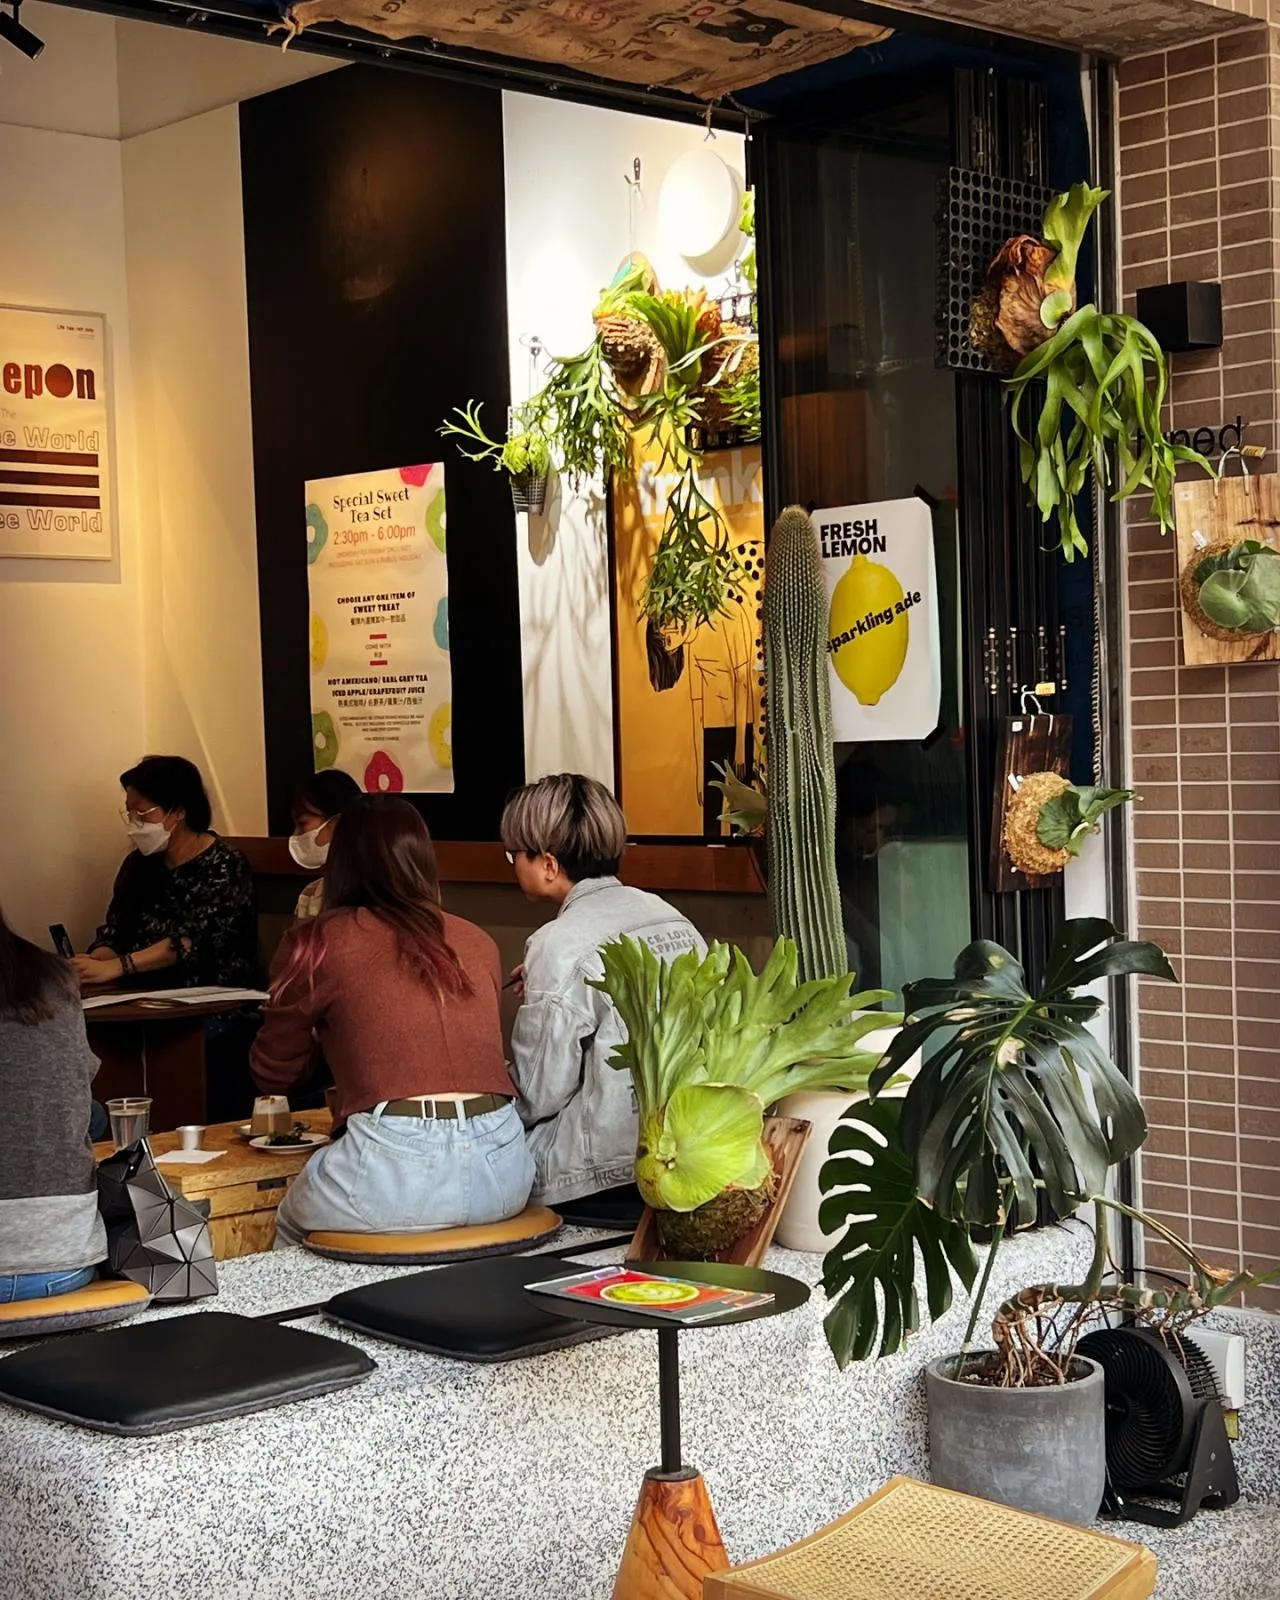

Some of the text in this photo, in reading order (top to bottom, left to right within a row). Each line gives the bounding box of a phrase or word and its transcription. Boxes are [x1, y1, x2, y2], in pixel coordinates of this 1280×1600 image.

[23, 426, 99, 451] World
[333, 487, 409, 512] Special Sweet
[26, 508, 102, 533] World
[350, 506, 392, 524] Tea Set
[333, 530, 368, 546] 2:30pm
[820, 519, 877, 541] FRESH
[822, 536, 886, 558] LEMON
[337, 596, 361, 605] CHOOSE
[362, 594, 375, 603] ANY
[376, 593, 390, 602] ONE
[353, 603, 400, 614] SWEET TREAT
[825, 591, 921, 653] sparkling ade
[327, 678, 341, 686] HOT
[398, 675, 414, 683] GREY
[415, 674, 428, 682] TEA
[332, 689, 346, 697] ICED
[407, 686, 426, 695] JUICE
[667, 929, 693, 941] LOVE
